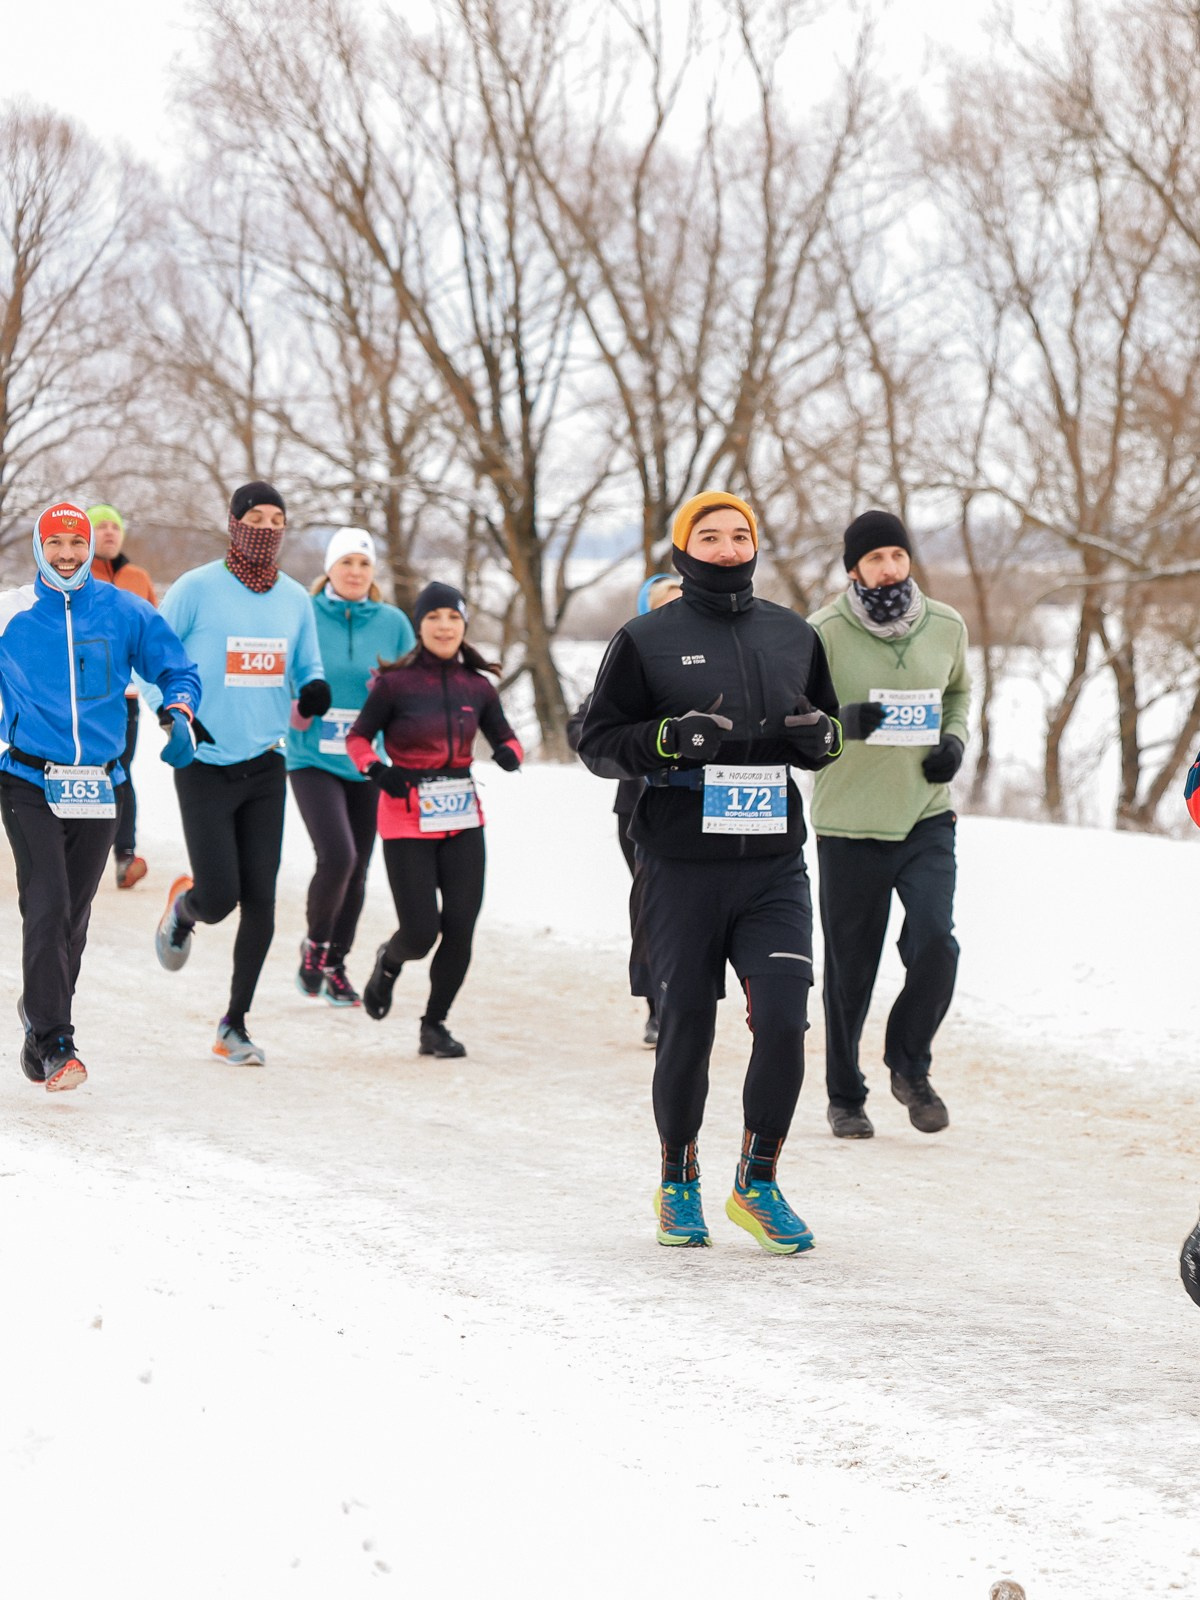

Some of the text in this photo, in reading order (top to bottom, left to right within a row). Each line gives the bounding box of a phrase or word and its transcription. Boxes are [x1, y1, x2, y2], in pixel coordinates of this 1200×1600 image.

[52, 510, 84, 520] LUKOIL
[241, 653, 275, 671] 140
[884, 706, 926, 725] 299
[61, 781, 99, 798] 163
[727, 787, 772, 811] 172
